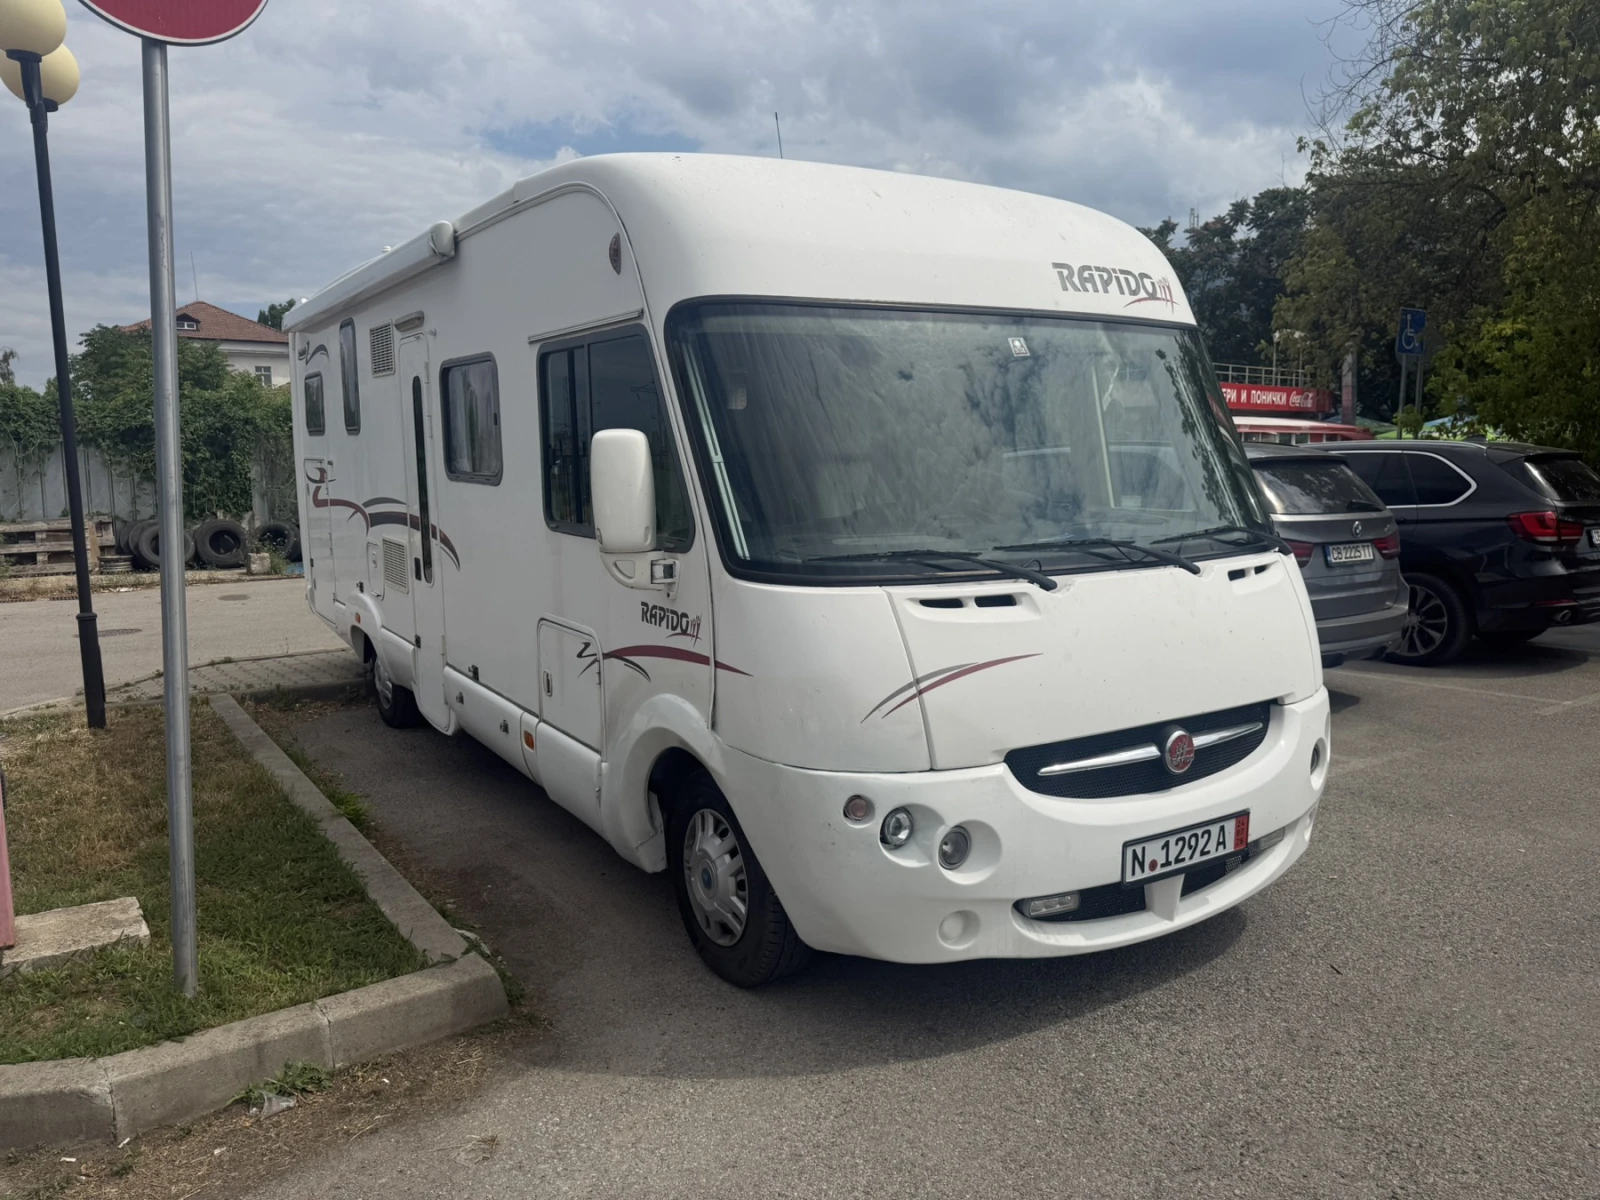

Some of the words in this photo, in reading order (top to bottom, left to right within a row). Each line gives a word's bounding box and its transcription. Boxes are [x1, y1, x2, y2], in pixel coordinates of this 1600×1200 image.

[1240, 389, 1247, 403] И
[1250, 390, 1287, 406] ПОНИЧКИ
[1160, 828, 1212, 868] 1292
